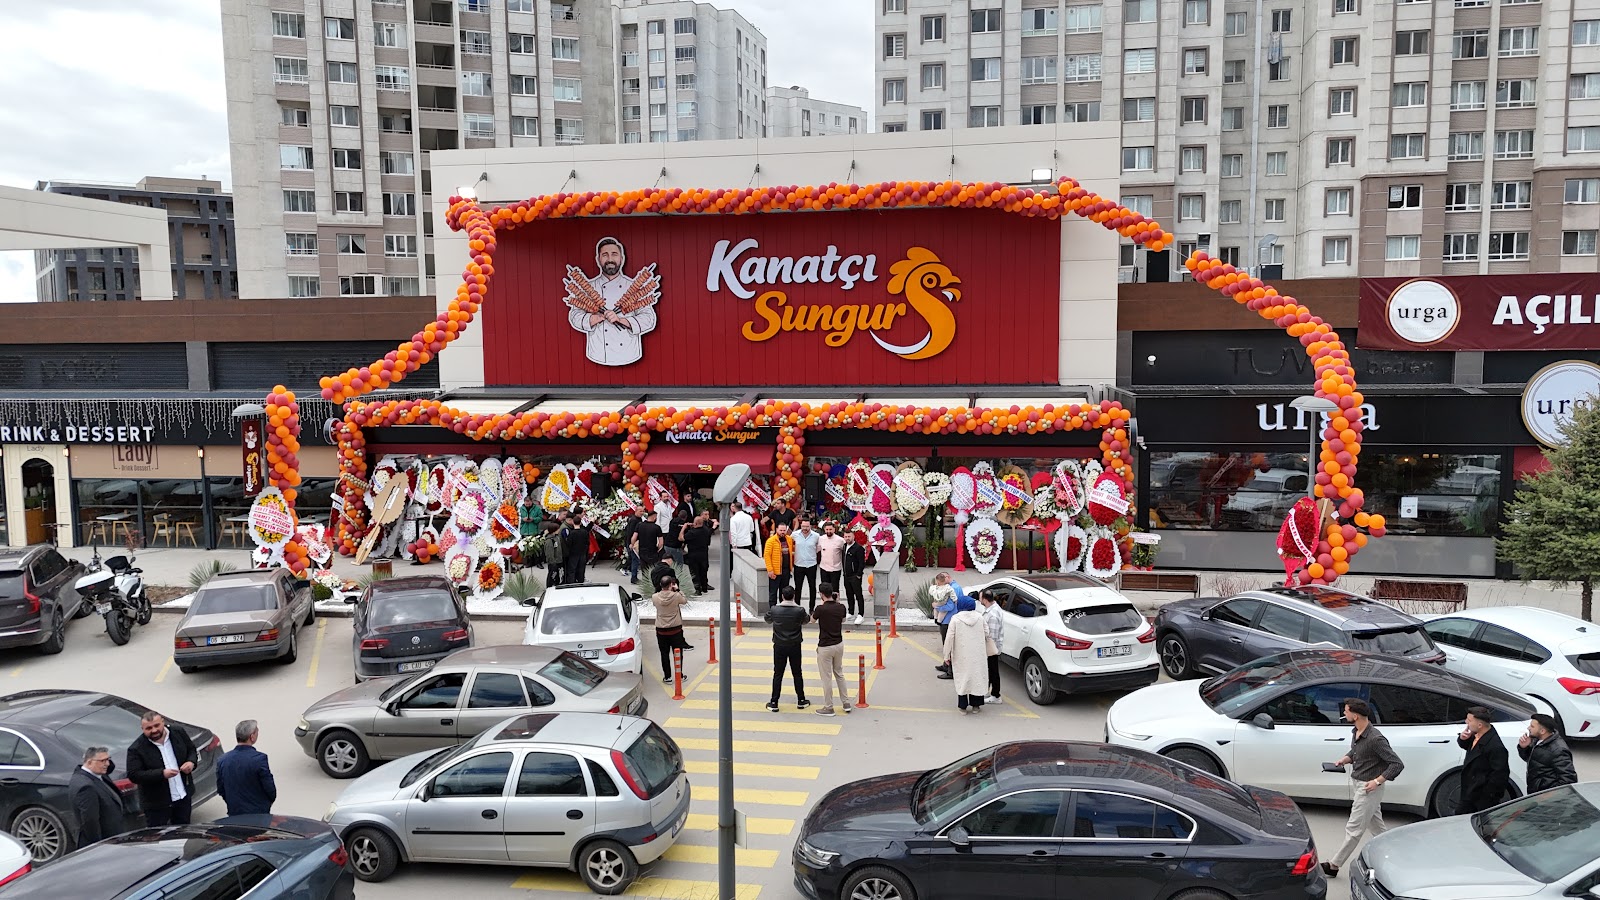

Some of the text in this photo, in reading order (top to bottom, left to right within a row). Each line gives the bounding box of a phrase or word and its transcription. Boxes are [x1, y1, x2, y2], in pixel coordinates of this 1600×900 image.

[706, 238, 878, 299] Kanatçı
[742, 291, 906, 347] Sungur
[1397, 305, 1448, 323] urga
[50, 429, 60, 442] &
[66, 426, 153, 442] DESSERT
[715, 428, 760, 444] Sungur
[117, 445, 153, 465] Lady
